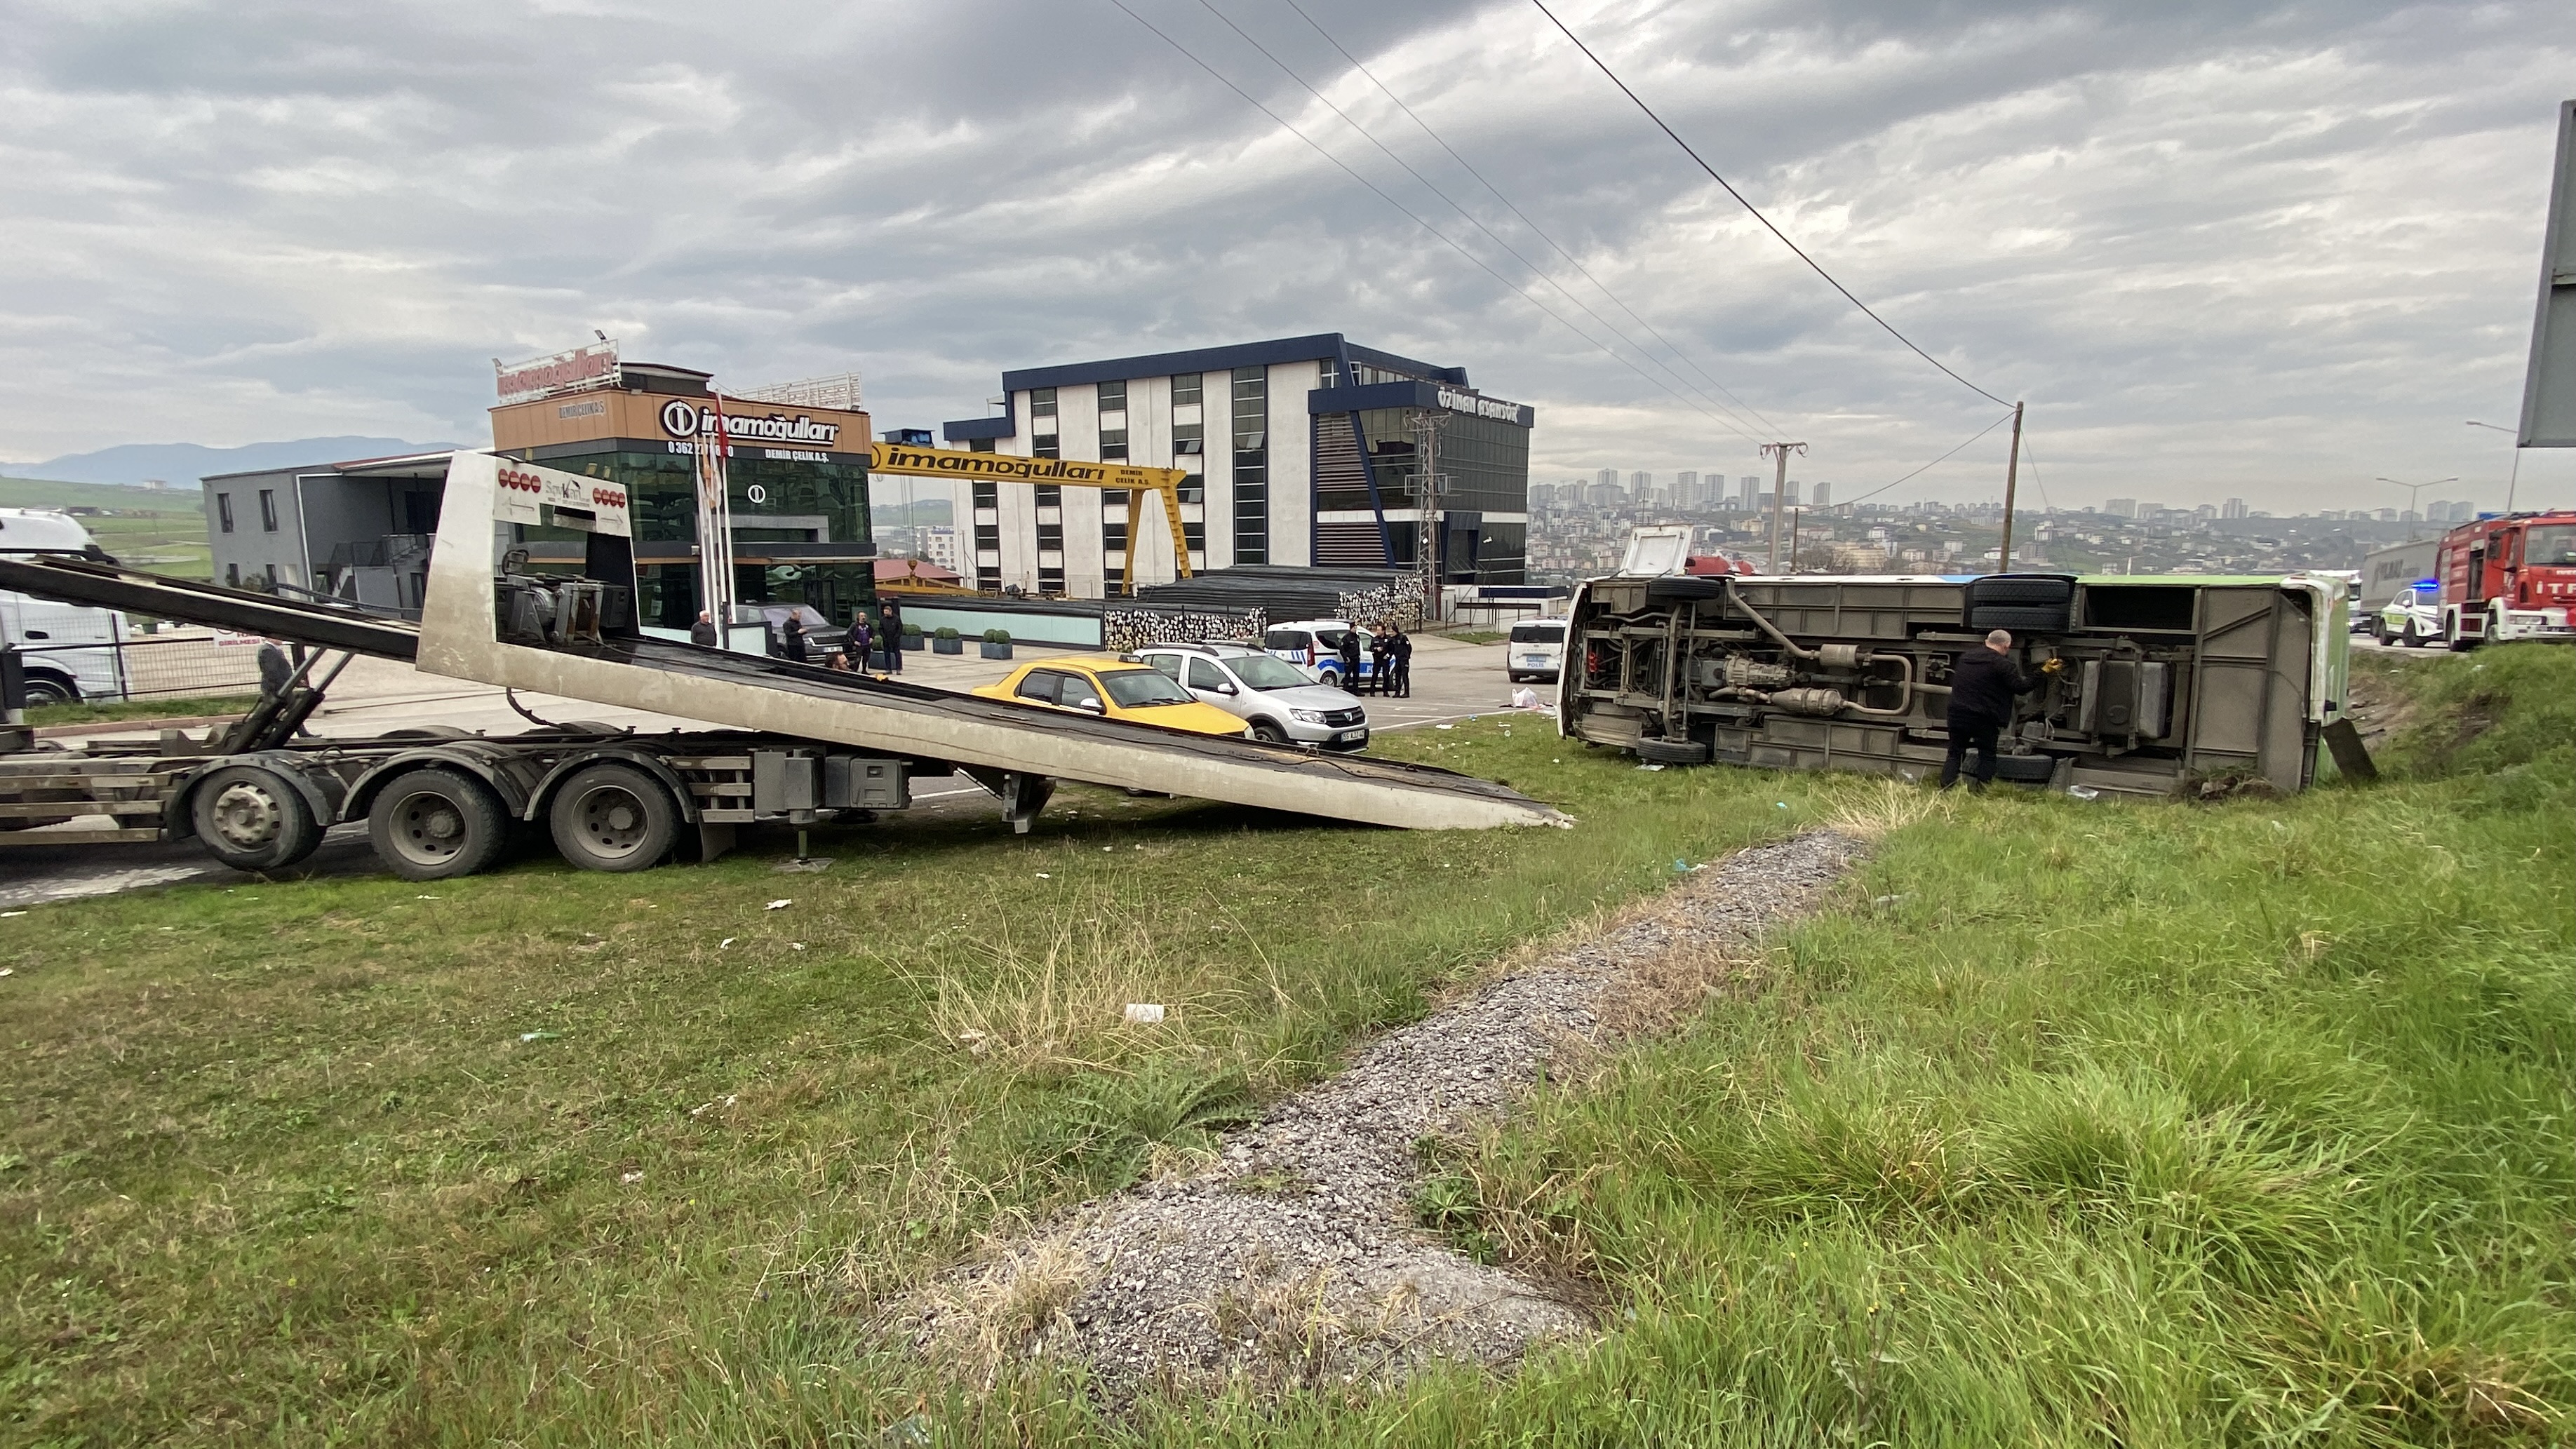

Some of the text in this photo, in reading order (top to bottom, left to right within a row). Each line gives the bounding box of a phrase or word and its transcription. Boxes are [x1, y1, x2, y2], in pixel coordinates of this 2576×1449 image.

[676, 442, 693, 454] 362
[765, 448, 791, 459] DEMİR
[792, 450, 815, 463] ÇELİK
[887, 447, 1105, 480] imamoğulları
